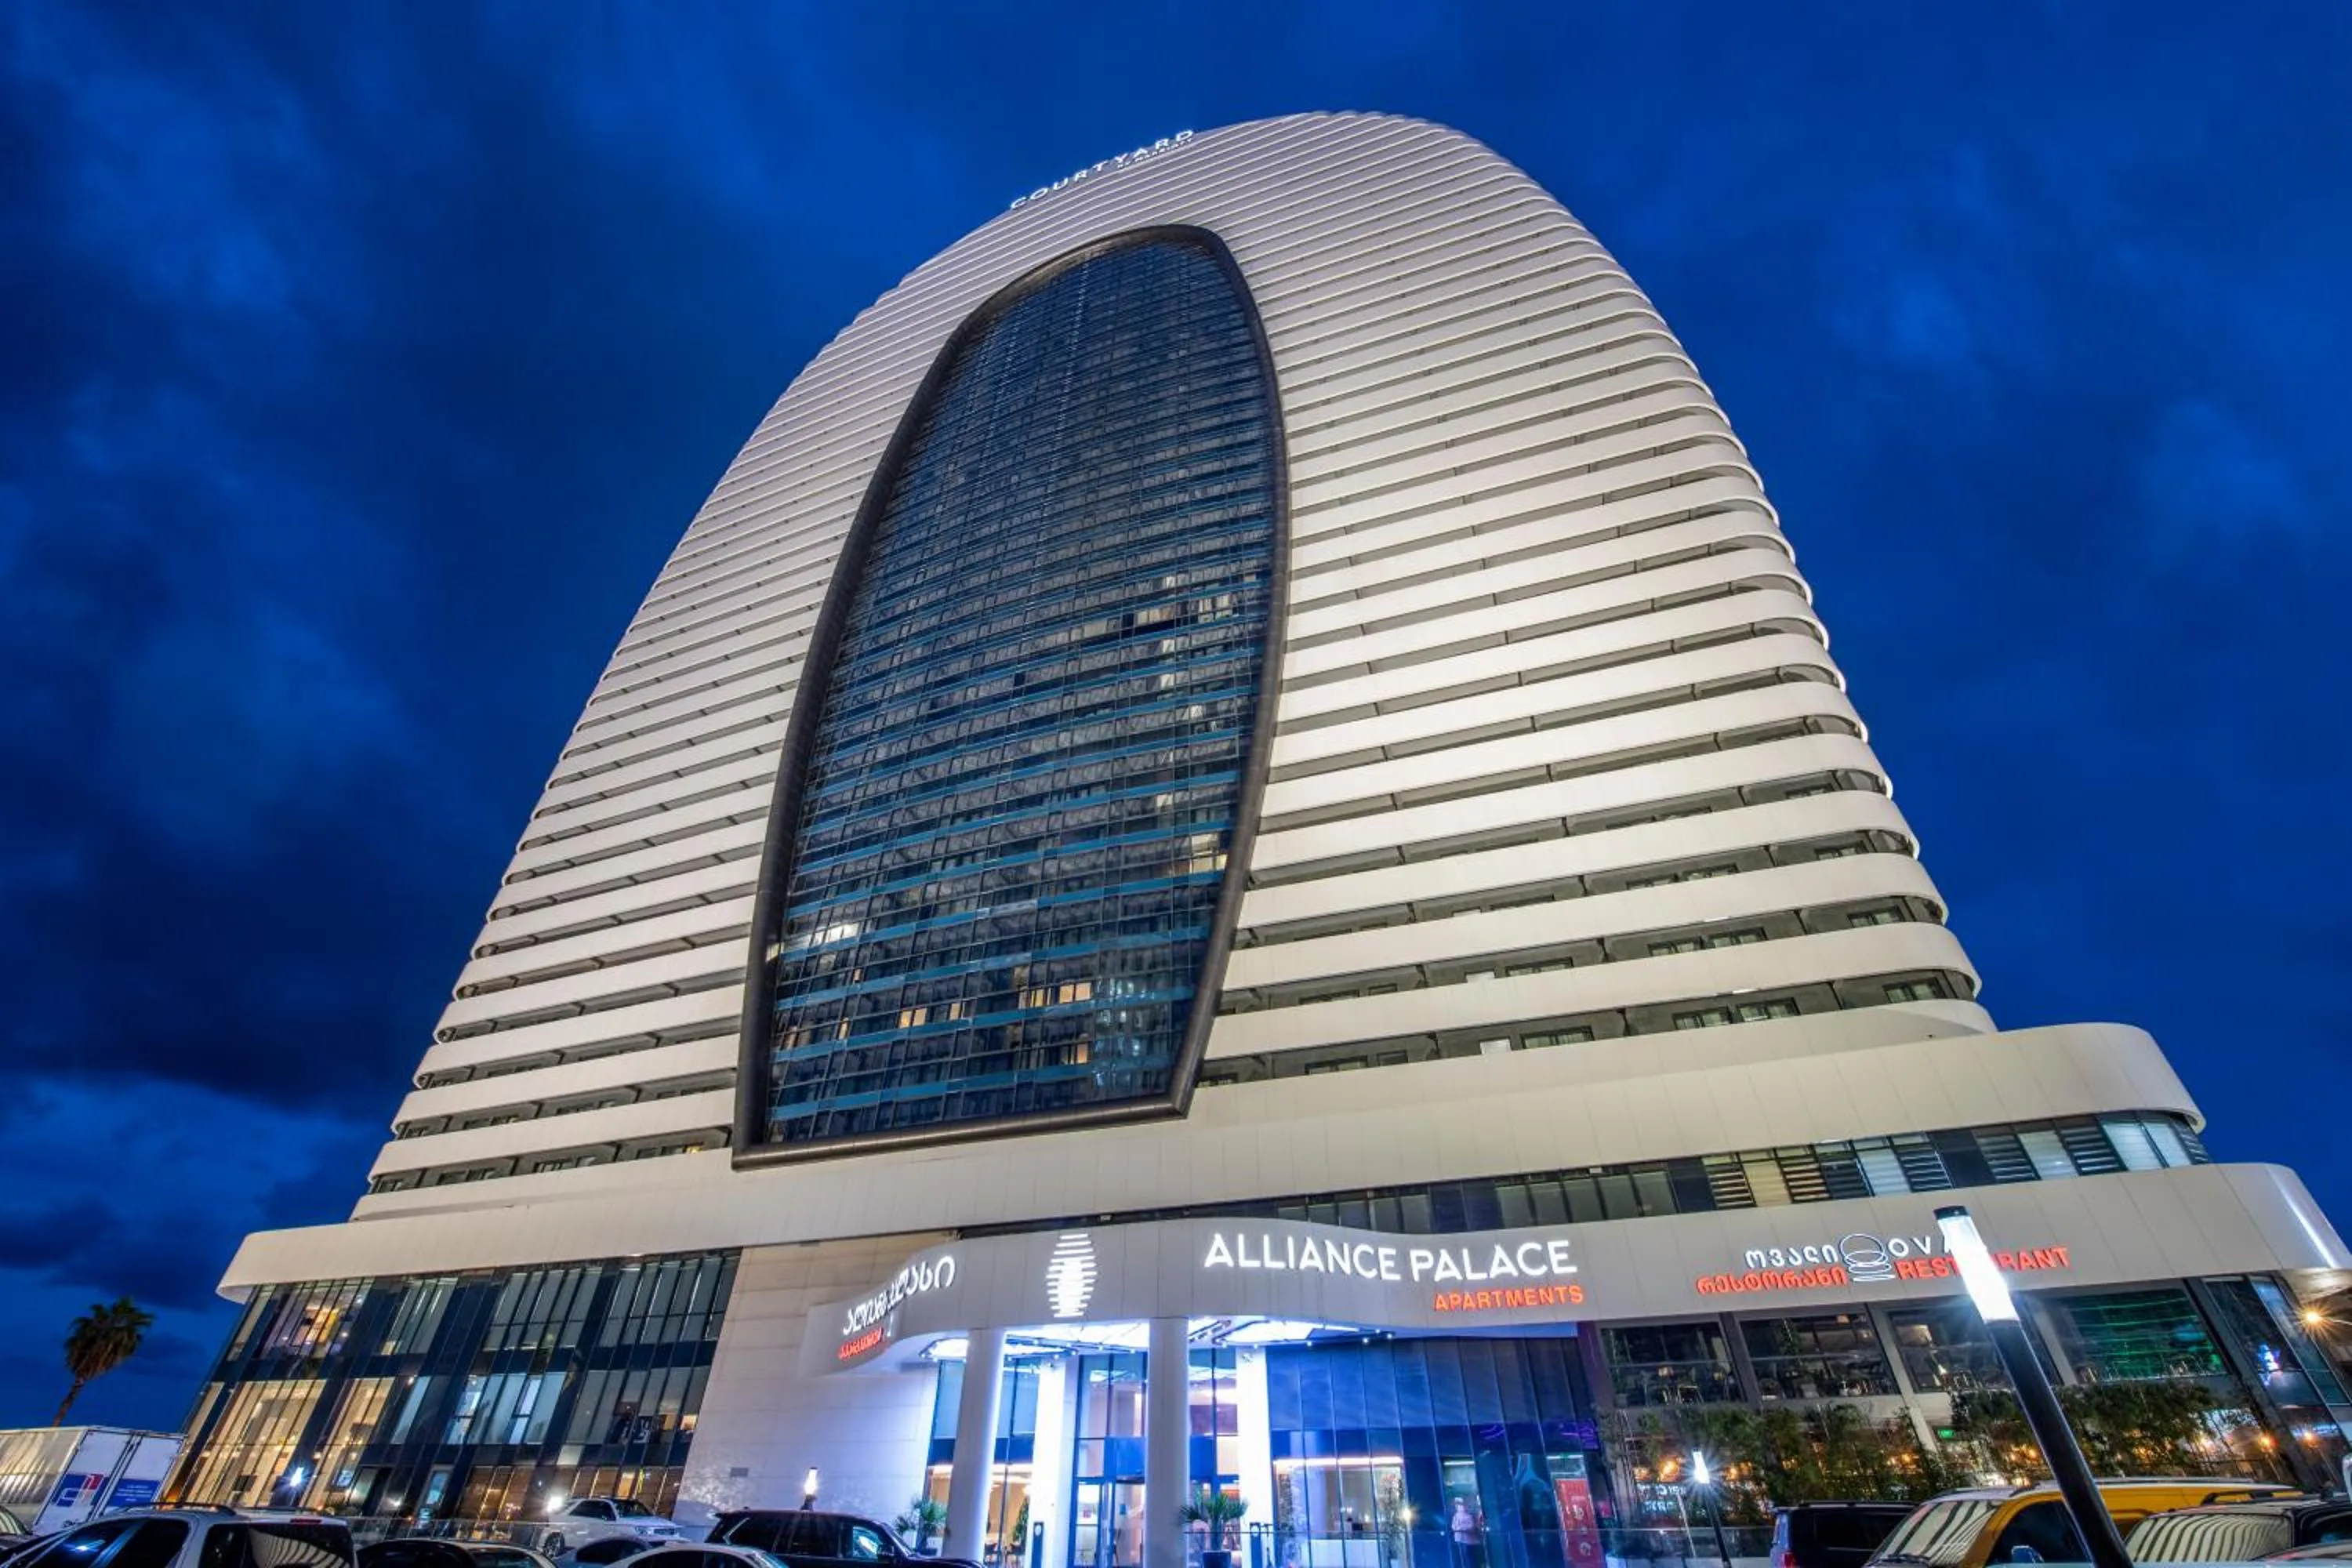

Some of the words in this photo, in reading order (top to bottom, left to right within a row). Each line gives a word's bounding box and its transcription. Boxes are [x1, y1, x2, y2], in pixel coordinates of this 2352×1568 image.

[1011, 129, 1194, 209] COURTYARD
[1203, 1232, 1402, 1282] ALLIANCE
[1409, 1239, 1579, 1283] PALACE
[1744, 1243, 1839, 1269] ოვალი
[1888, 1235, 1952, 1258] OV
[1894, 1243, 2071, 1281] RESTRANT
[1696, 1263, 1849, 1296] რესტორანი
[1434, 1283, 1584, 1312] APARTMENTS
